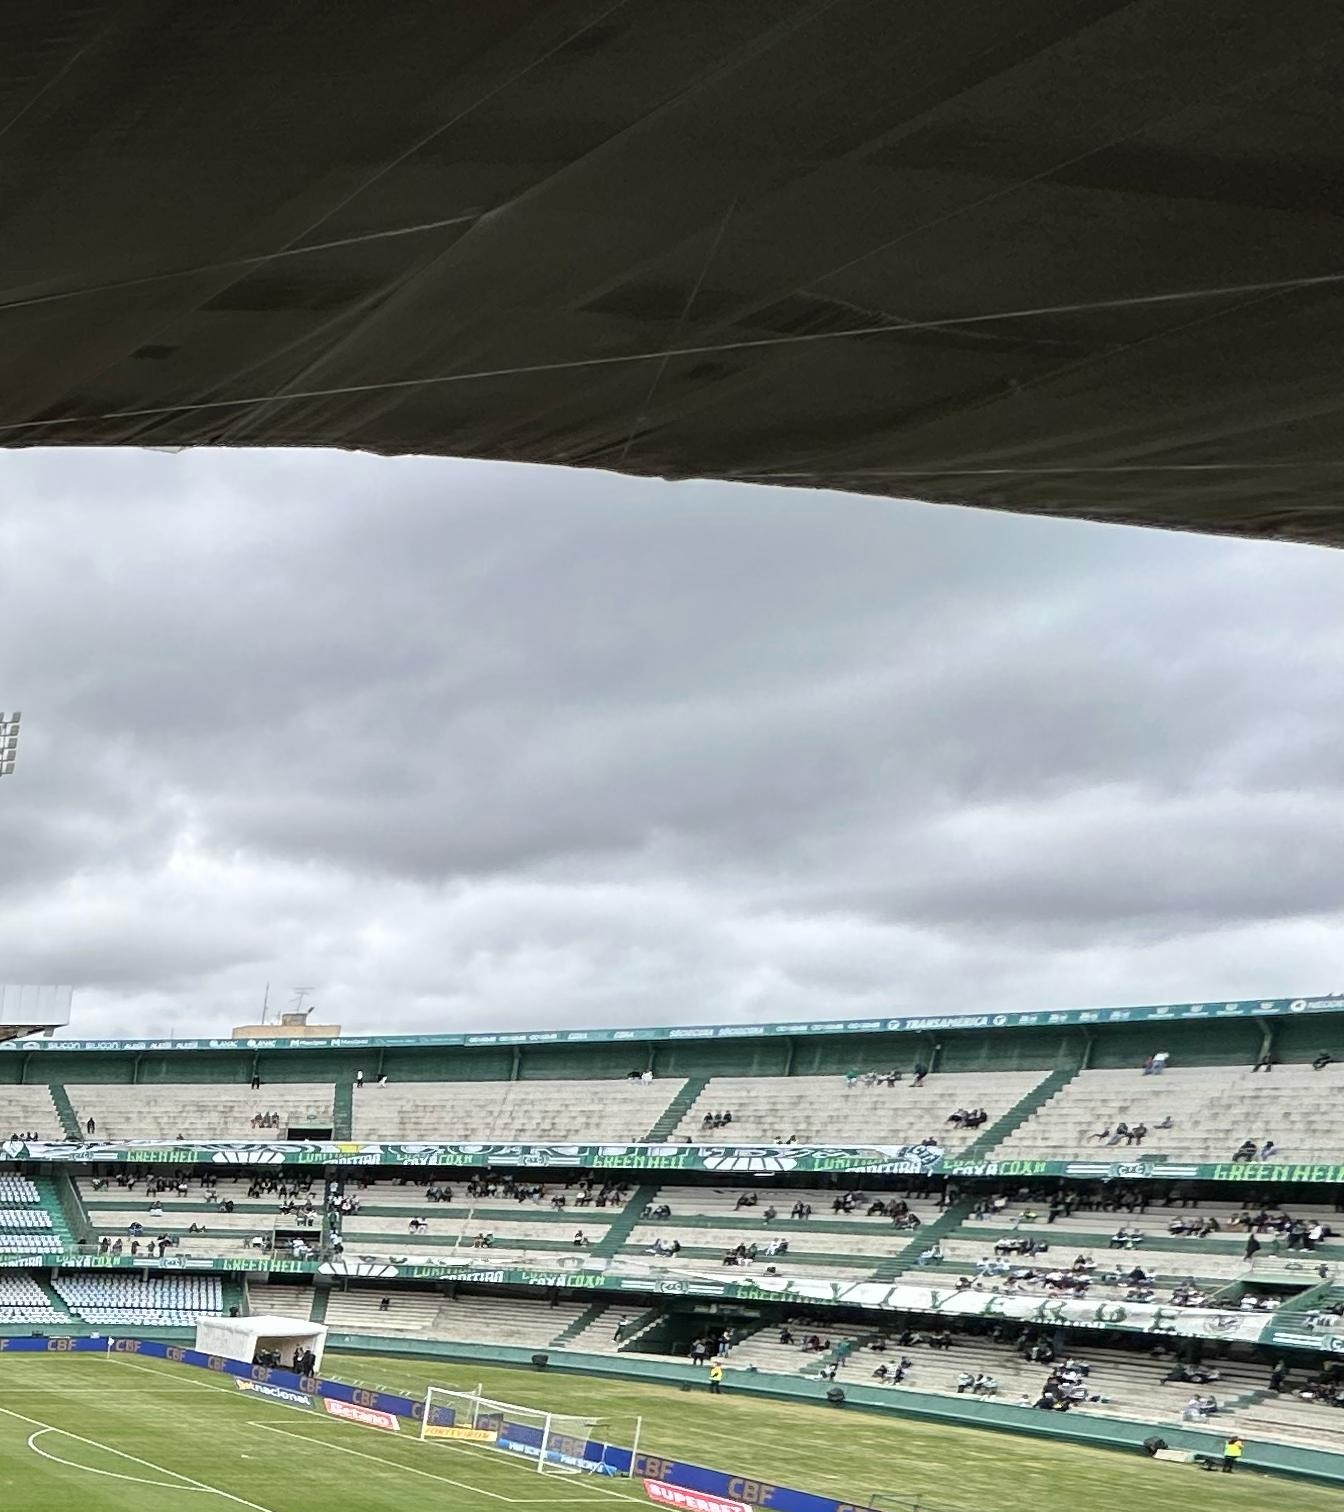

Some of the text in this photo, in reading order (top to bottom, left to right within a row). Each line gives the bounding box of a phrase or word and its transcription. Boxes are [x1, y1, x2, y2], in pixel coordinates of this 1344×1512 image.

[47, 1338, 77, 1352] CBF
[115, 1338, 141, 1352] CBF
[207, 1355, 228, 1373] CBF
[251, 1365, 273, 1383] CBF
[299, 1375, 322, 1395] CBF
[352, 1388, 379, 1408] CBF
[728, 1477, 776, 1505] CBF
